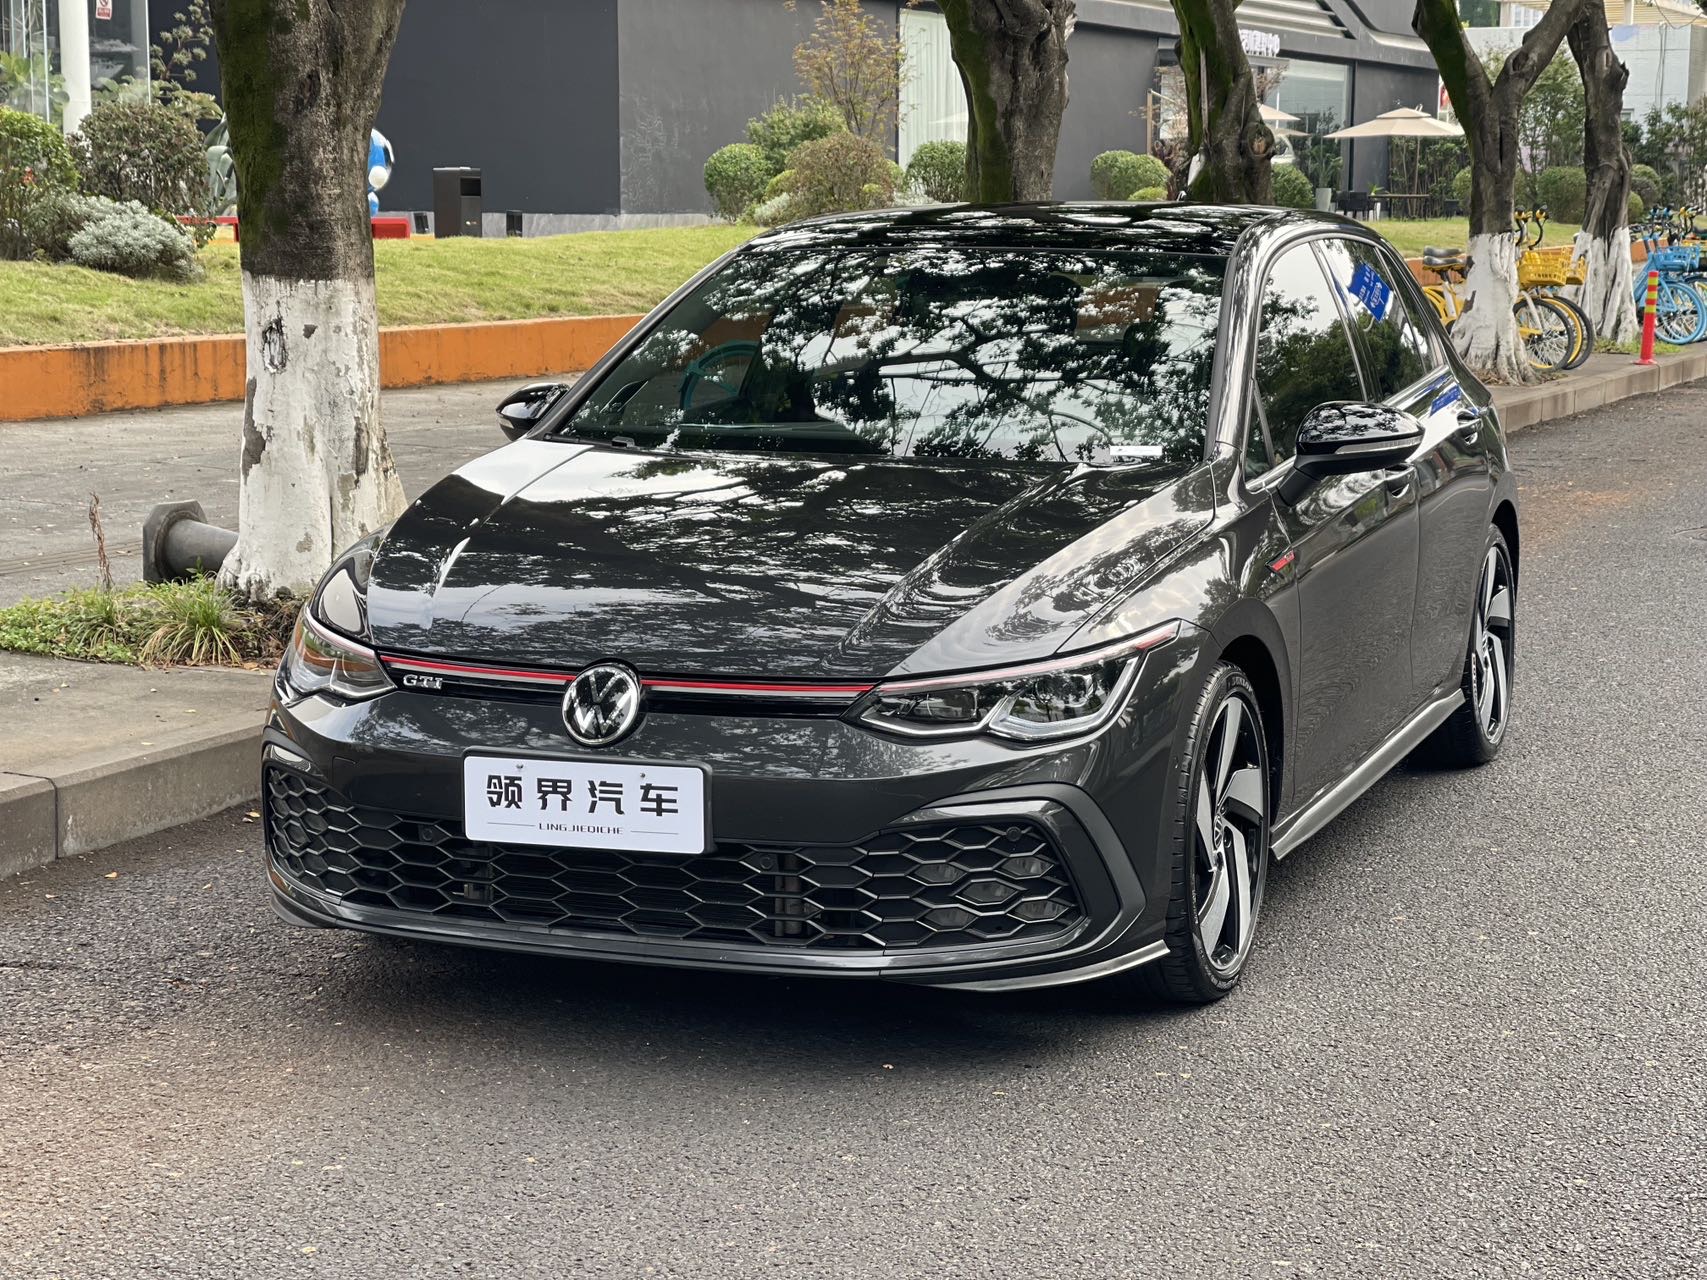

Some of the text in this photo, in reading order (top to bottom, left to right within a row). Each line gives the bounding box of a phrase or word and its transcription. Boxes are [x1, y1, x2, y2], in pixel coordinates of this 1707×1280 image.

[403, 674, 443, 690] GTI
[486, 774, 679, 817] 领界汽车
